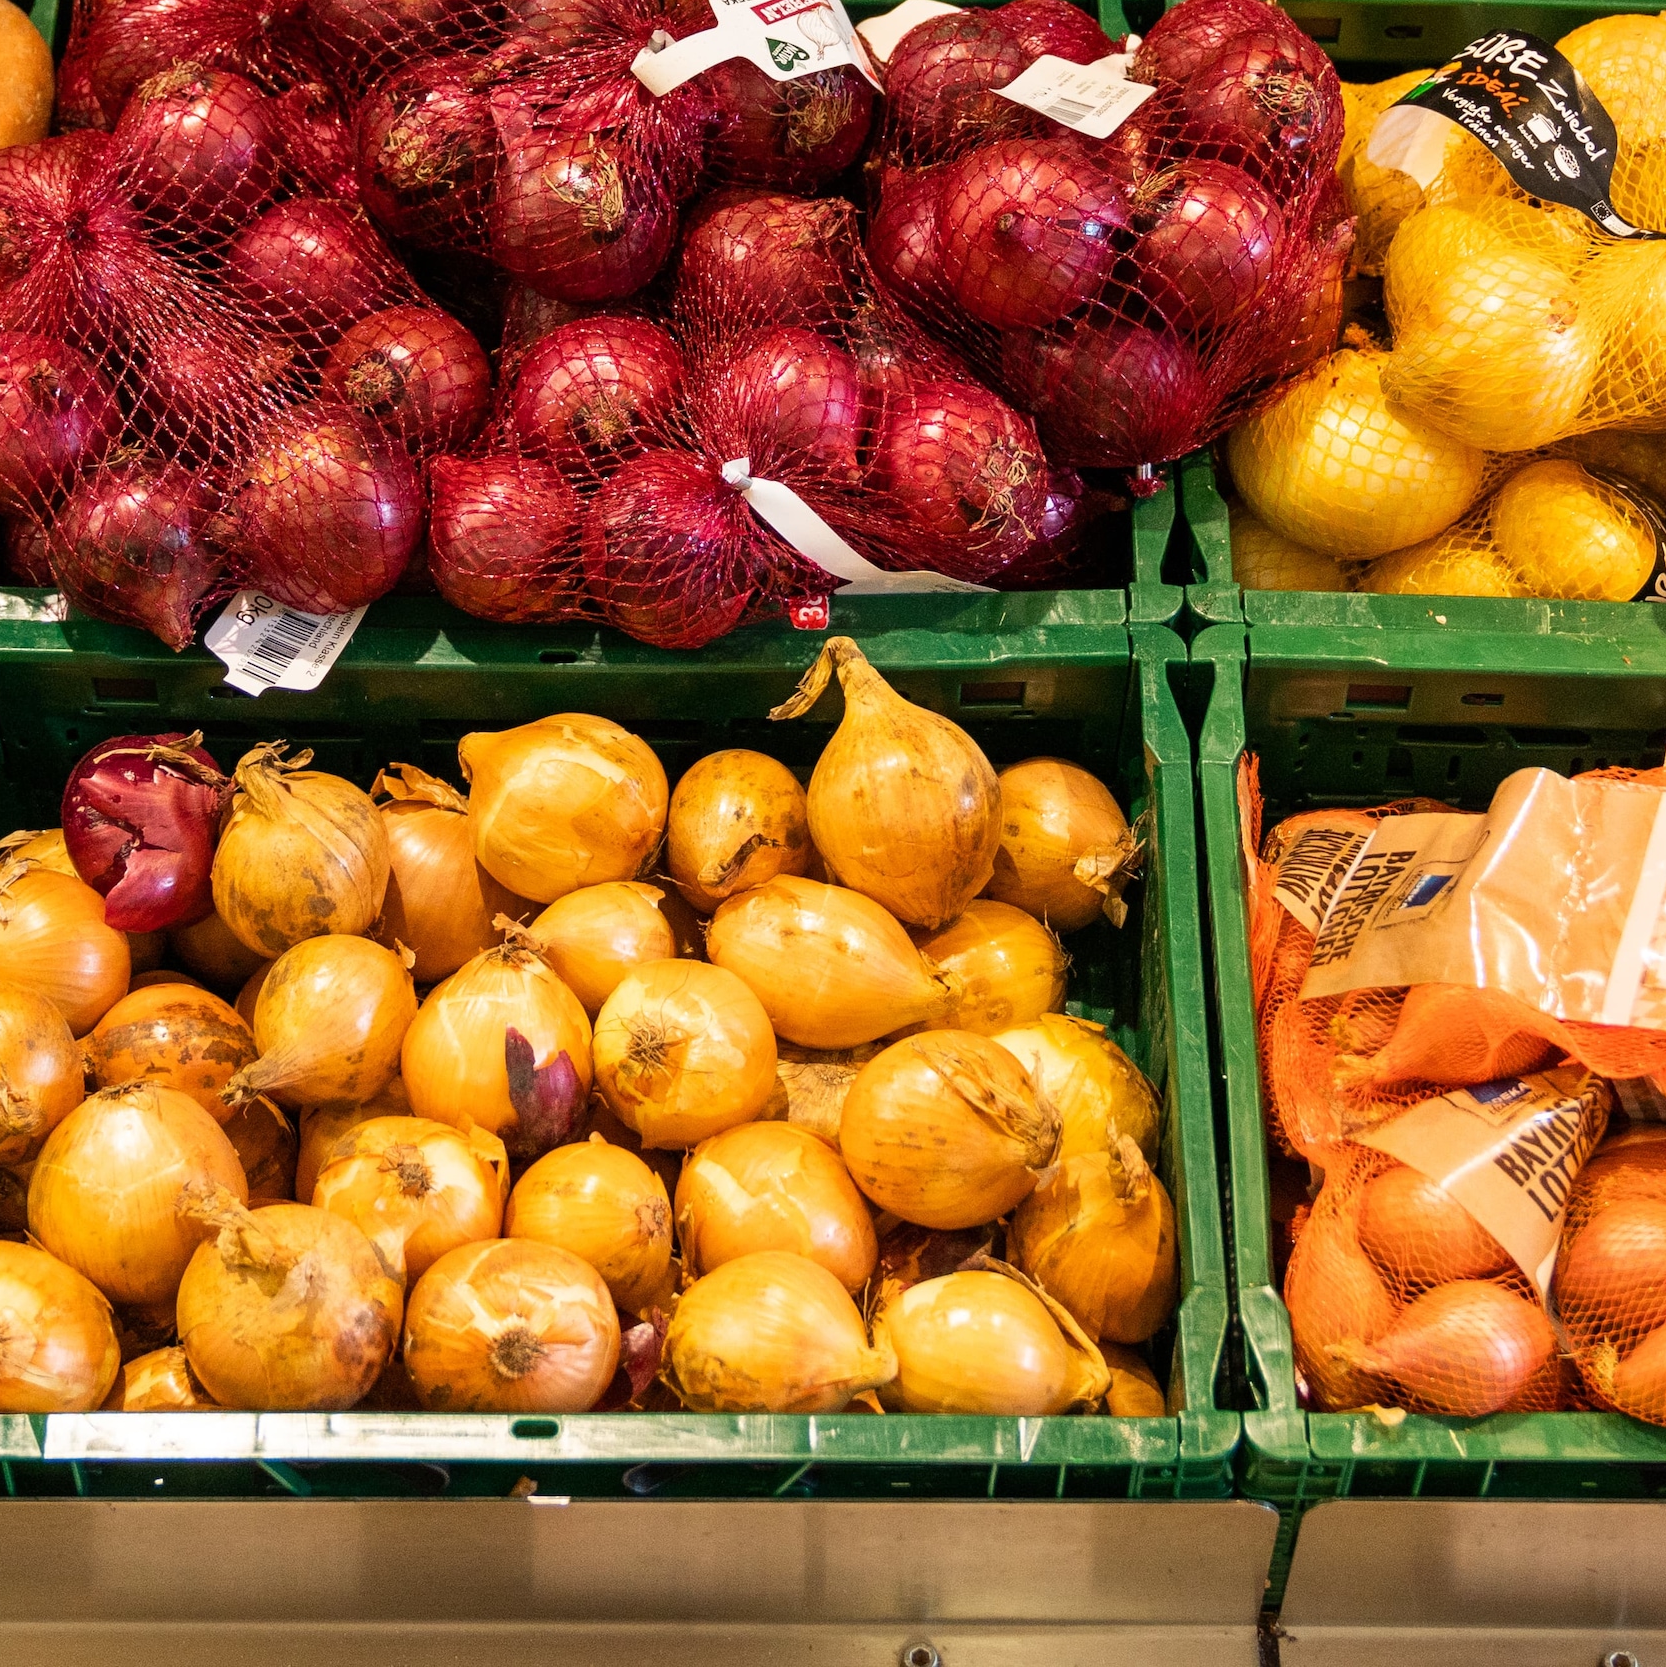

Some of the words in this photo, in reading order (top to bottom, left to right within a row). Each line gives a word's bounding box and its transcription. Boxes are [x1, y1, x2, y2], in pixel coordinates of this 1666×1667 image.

[1441, 87, 1493, 124] Vergieße
[1493, 123, 1536, 170] weniger
[1458, 108, 1500, 148] Tränen
[1535, 78, 1607, 161] Zwiebel
[307, 613, 338, 650] tschland
[331, 608, 356, 641] wiebeln
[311, 639, 337, 670] Klasse
[1325, 851, 1415, 964] BAYRISCHE
